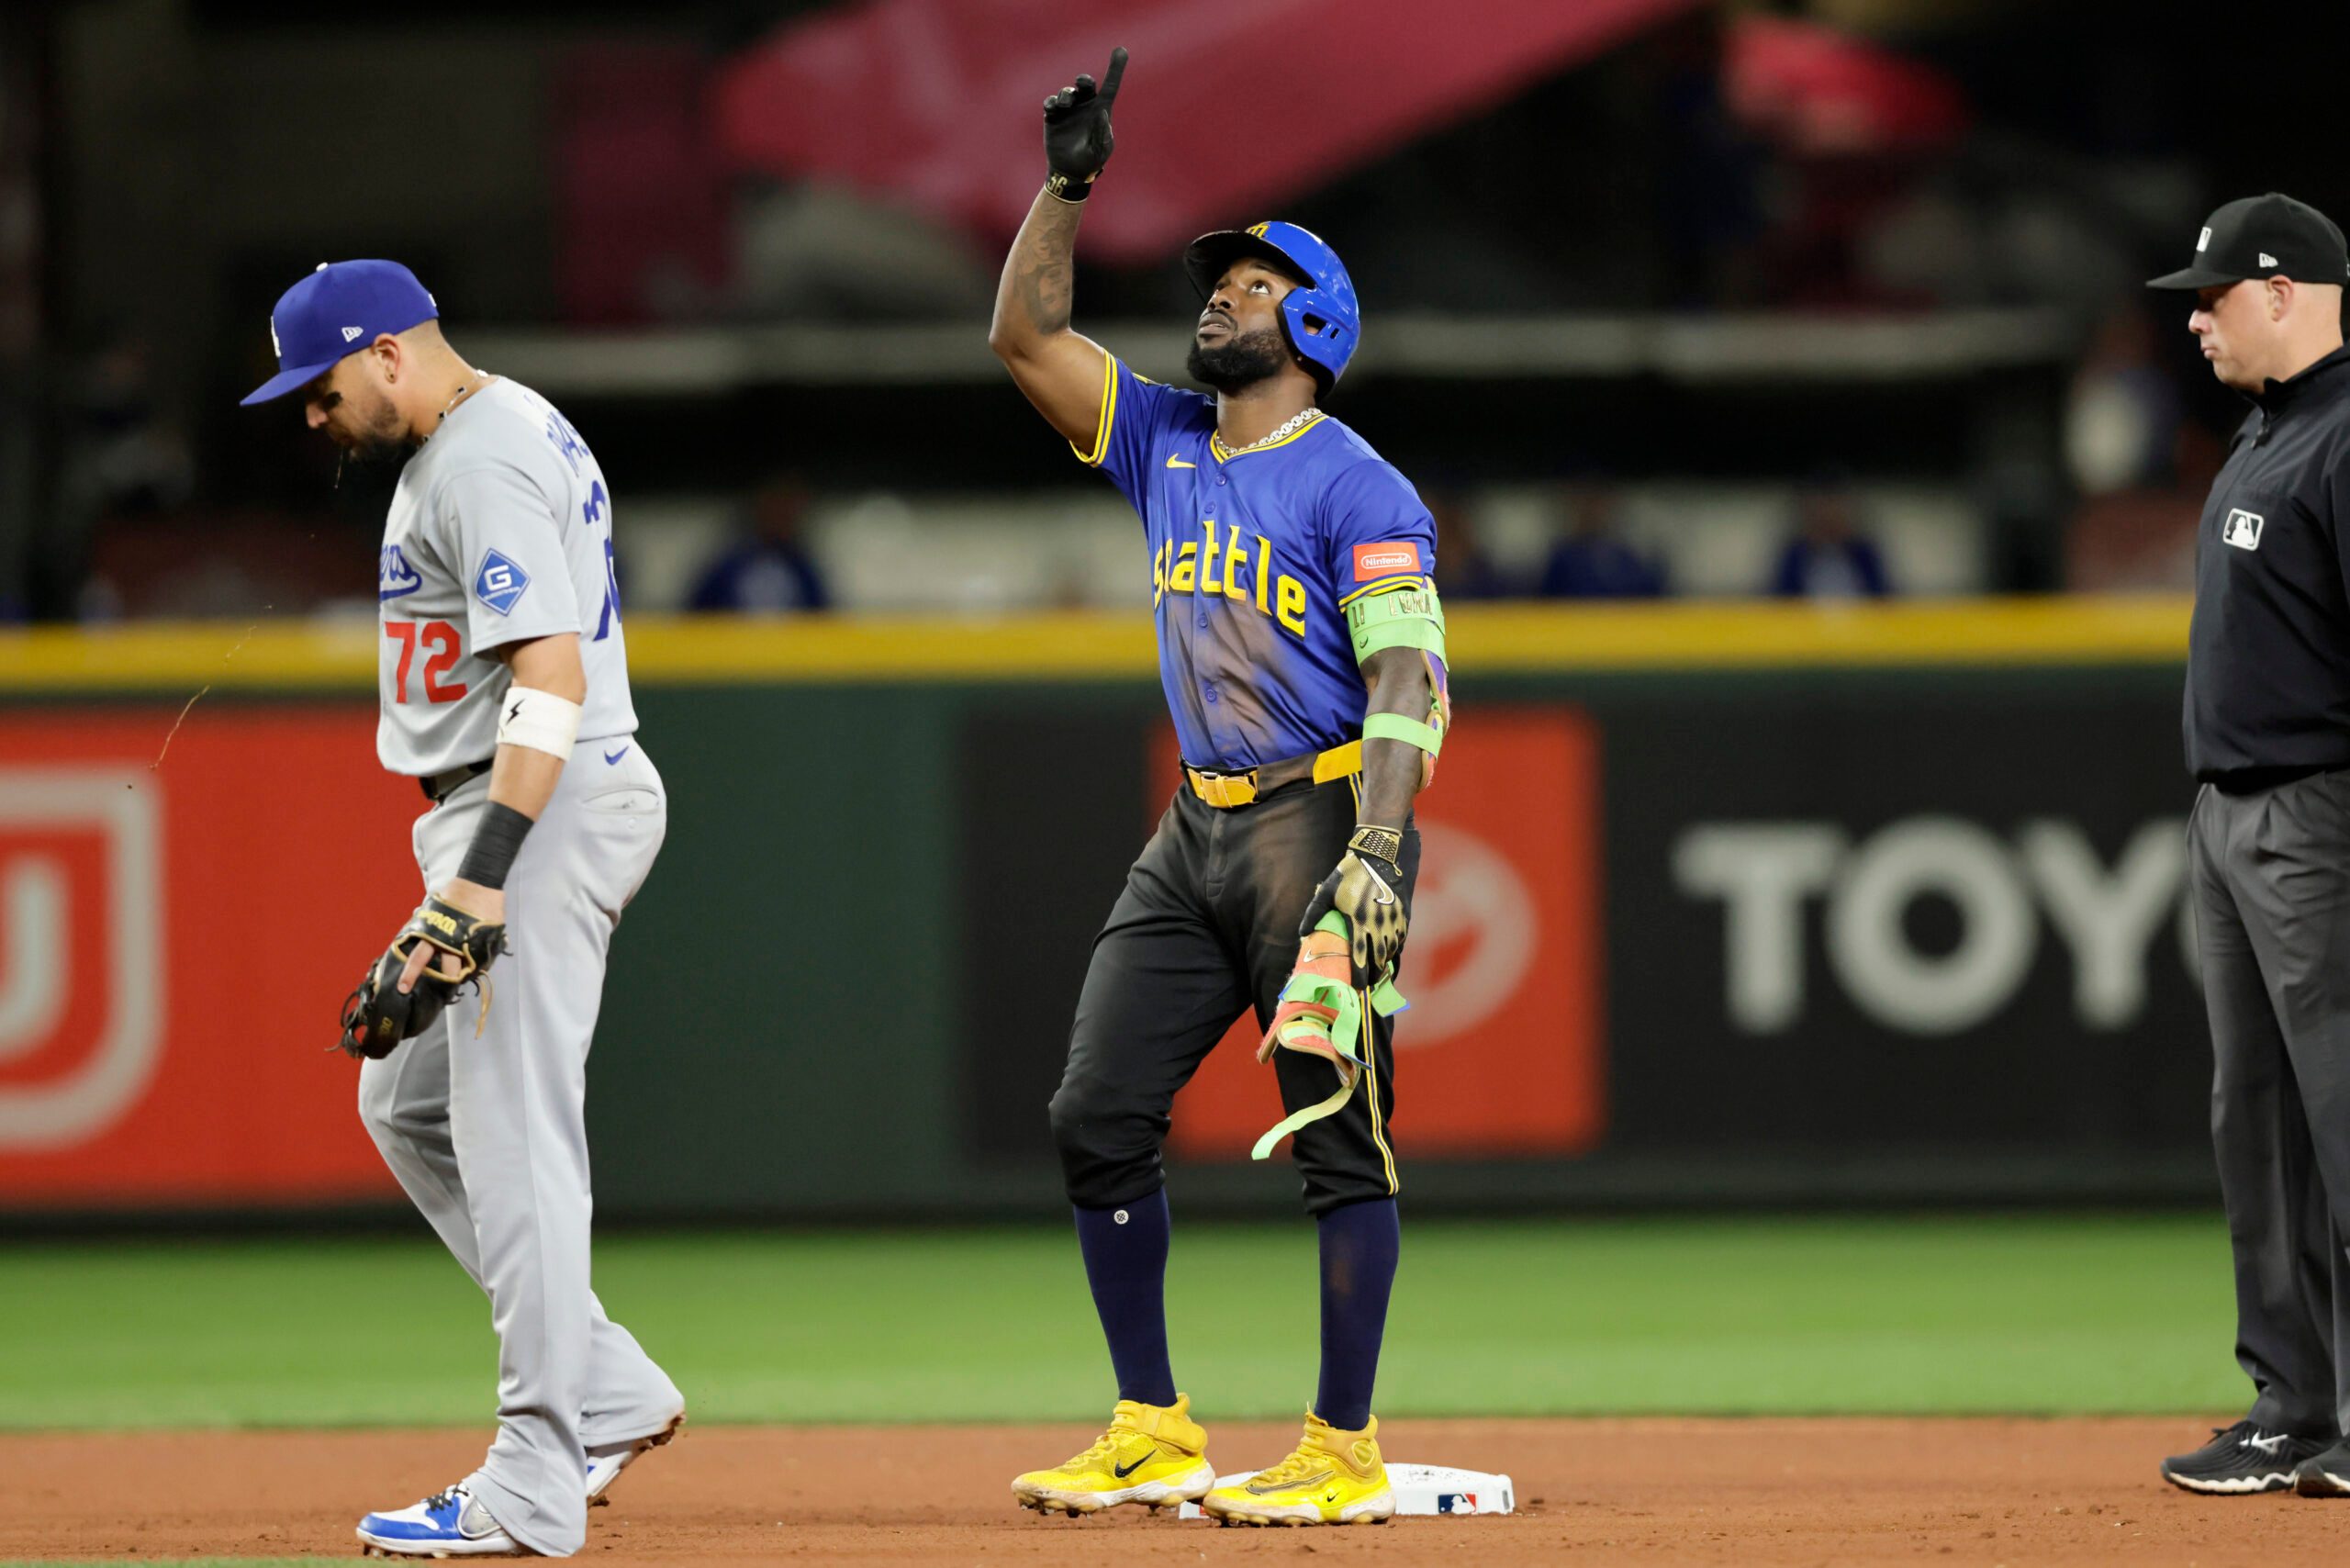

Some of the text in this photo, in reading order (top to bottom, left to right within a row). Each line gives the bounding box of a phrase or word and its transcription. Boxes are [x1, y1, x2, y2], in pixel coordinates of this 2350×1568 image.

[1364, 555, 1409, 567] Nintendo
[385, 620, 468, 705] 72
[1670, 813, 2205, 1034] TOY
